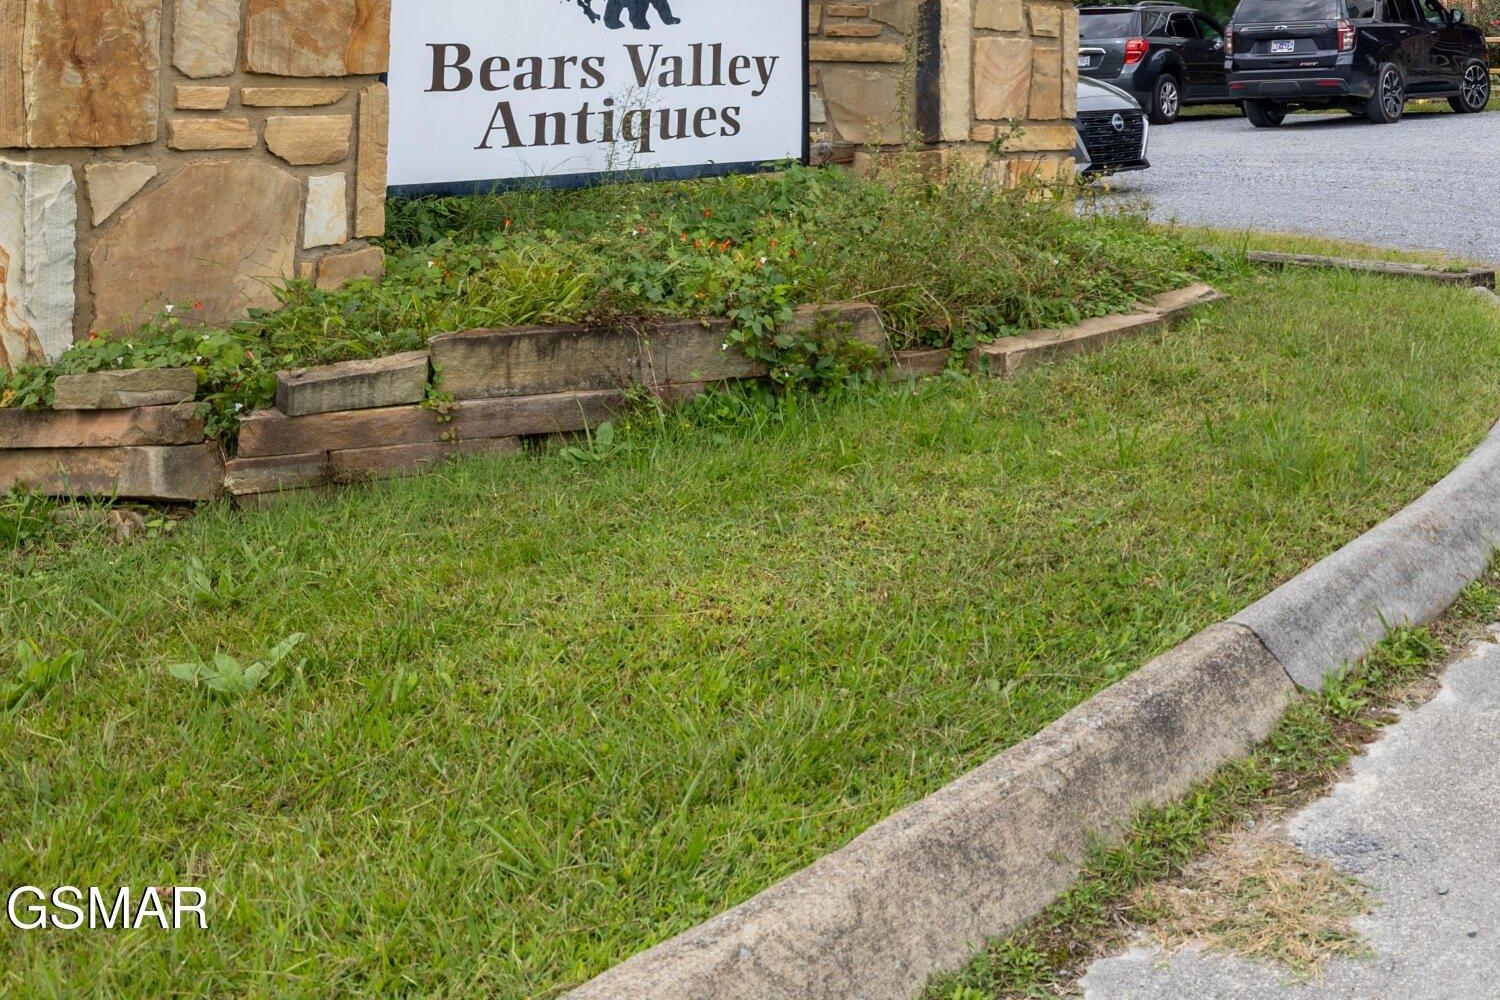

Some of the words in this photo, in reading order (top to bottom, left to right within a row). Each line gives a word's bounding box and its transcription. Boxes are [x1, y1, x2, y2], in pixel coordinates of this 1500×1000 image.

[424, 42, 605, 92] Bears
[623, 42, 780, 97] Valley
[473, 97, 741, 154] Antiques
